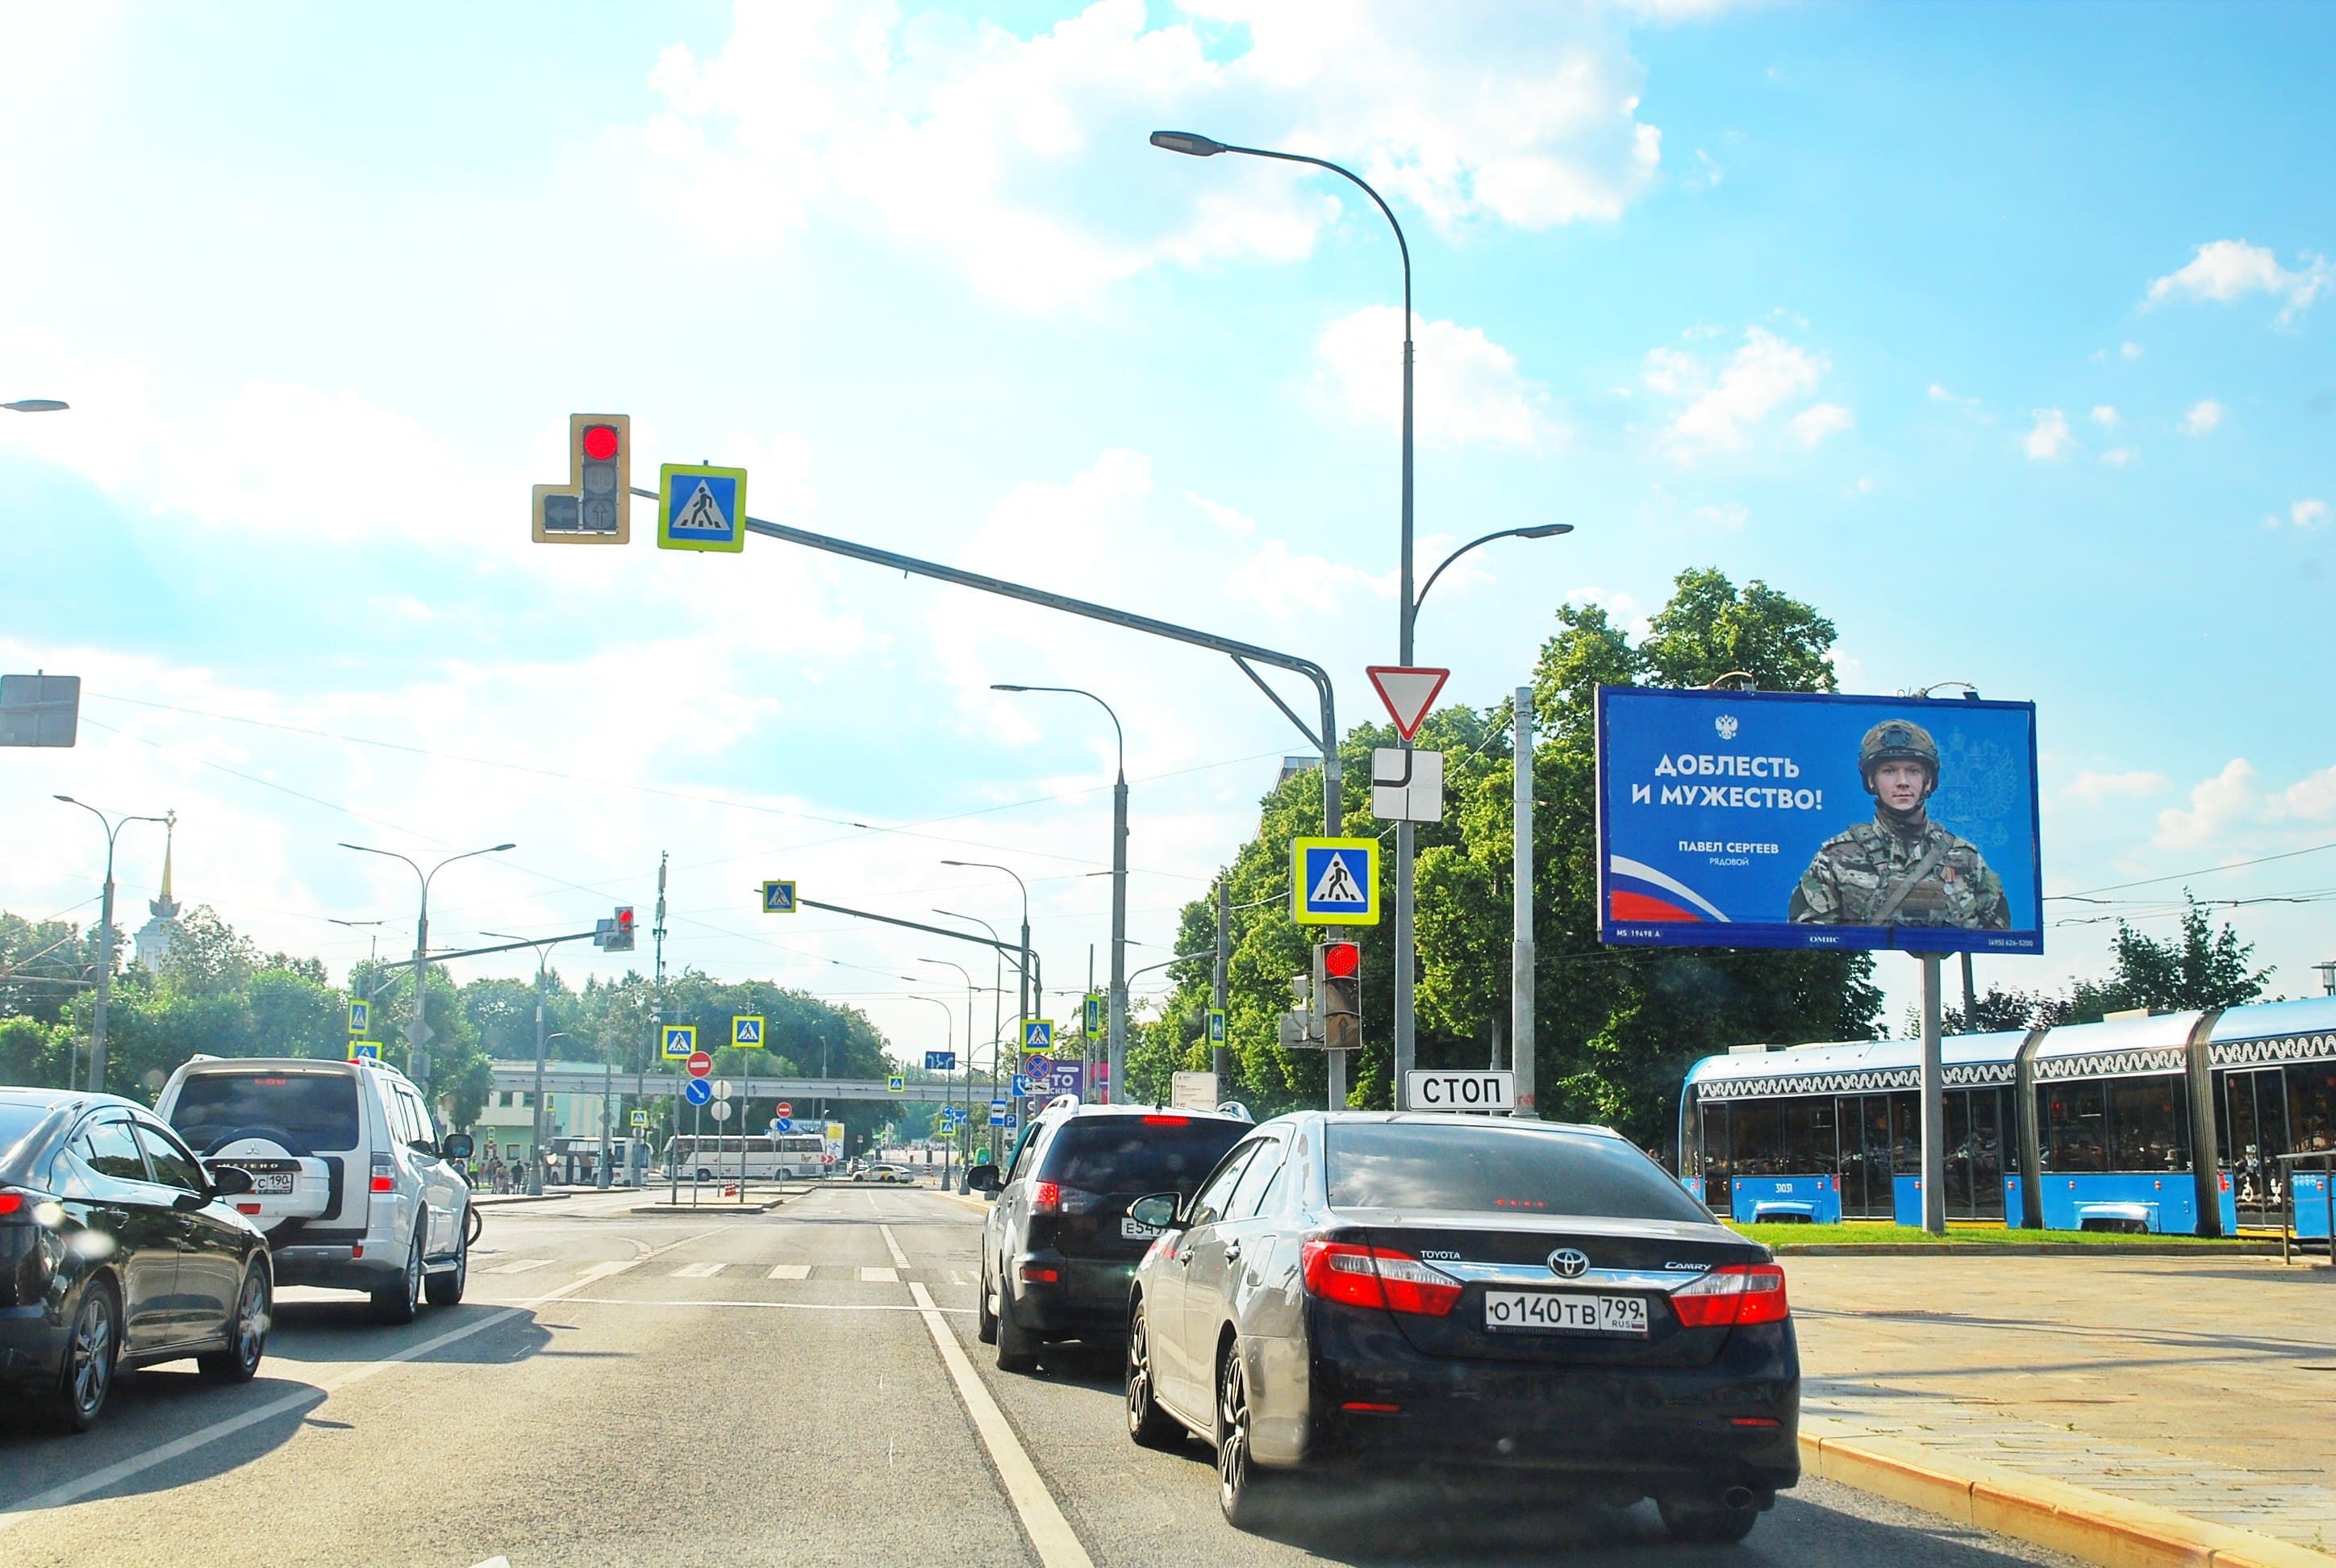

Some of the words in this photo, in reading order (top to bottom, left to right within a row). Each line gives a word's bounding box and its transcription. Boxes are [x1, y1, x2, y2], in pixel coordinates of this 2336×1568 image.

[1654, 753, 1800, 778] ДОБЛЕСТЬ
[1632, 783, 1650, 804] И
[1660, 784, 1822, 810] МУЖЕСТВО!
[1679, 840, 1723, 853] ПАВЕЛ
[1726, 843, 1779, 854] СЕРГЕЕВ
[1709, 857, 1749, 865] РЯДОВОЙ
[1423, 1078, 1501, 1103] СТОП
[1420, 1250, 1461, 1259] TOYOTA
[1601, 1298, 1641, 1320] 799
[1612, 1320, 1631, 1328] RUS
